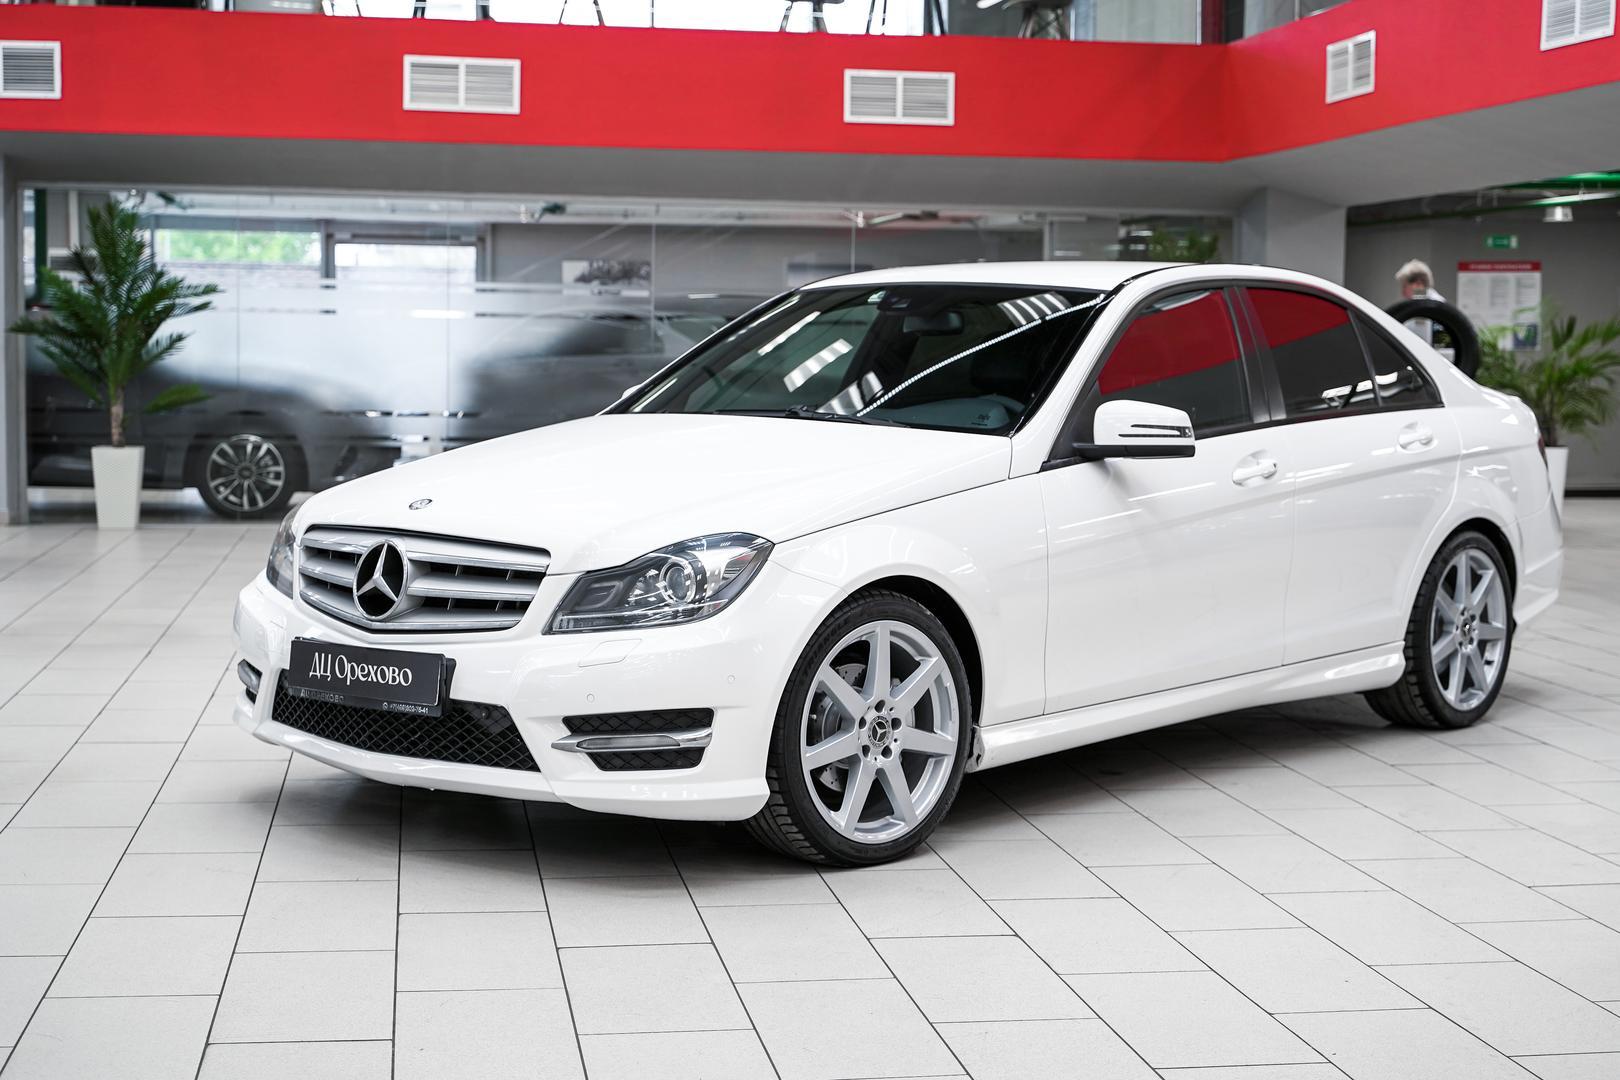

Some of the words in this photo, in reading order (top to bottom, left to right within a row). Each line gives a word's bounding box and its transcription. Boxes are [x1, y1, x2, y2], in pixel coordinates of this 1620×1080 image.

[309, 652, 332, 681] ДЦ
[335, 654, 413, 686] Орехово
[801, 618, 849, 679] TRIANGLE
